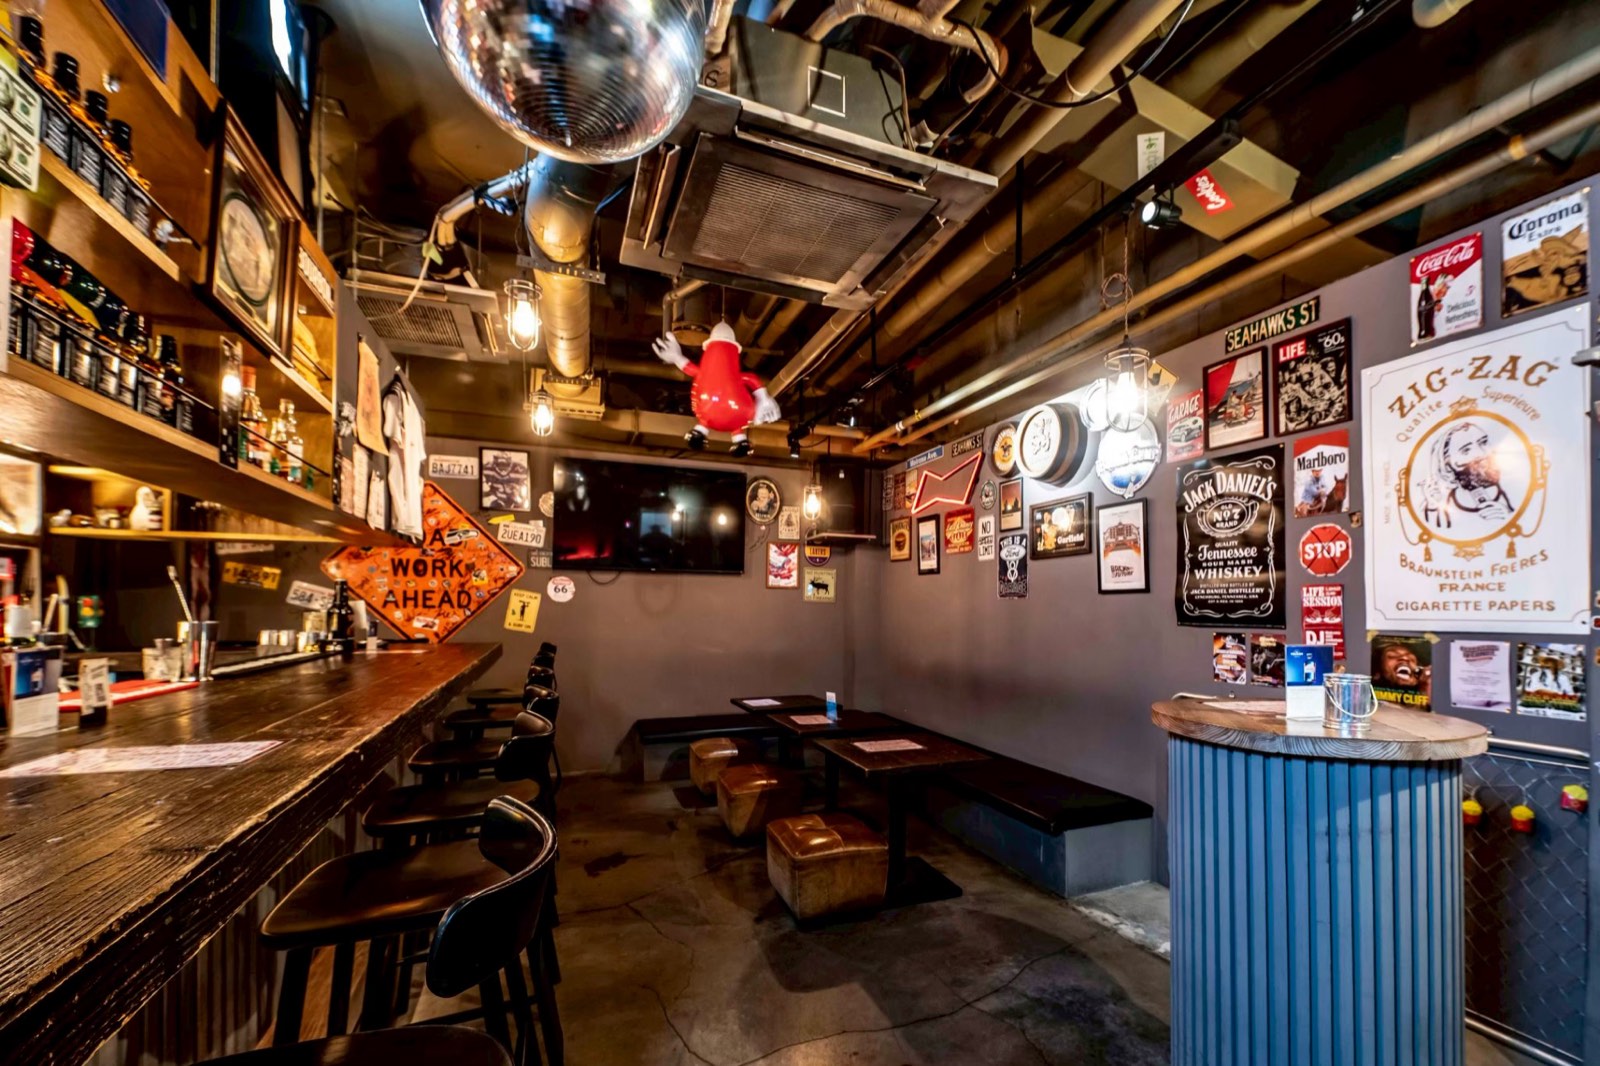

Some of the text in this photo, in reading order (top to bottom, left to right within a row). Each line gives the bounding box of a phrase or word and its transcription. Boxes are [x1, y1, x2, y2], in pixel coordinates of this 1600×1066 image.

[1508, 201, 1584, 241] Corona
[1527, 226, 1562, 242] Extra
[1227, 308, 1295, 352] SEAHAWKS
[1299, 299, 1317, 325] ST
[1279, 341, 1306, 363] LIFE
[1388, 355, 1560, 419] ZIG-ZAG
[1168, 394, 1201, 424] GARAGE
[431, 462, 474, 476] BAJ7741
[1296, 451, 1346, 472] Marlboro
[1183, 471, 1277, 513] JACK DANIEL'S
[981, 521, 991, 535] NO
[1215, 520, 1238, 528] BRAND
[501, 528, 542, 544] 2UEA190
[1000, 535, 1026, 549] THIS IS A
[1057, 532, 1084, 545] Garfield
[1215, 540, 1239, 548] QUALITY
[1198, 544, 1258, 561] Tennessee
[1304, 540, 1347, 561] STOP
[390, 558, 464, 578] WORK
[1194, 565, 1263, 580] WHISKEY
[1399, 553, 1483, 580] BRAUNSTEIN
[553, 585, 568, 593] 66
[1302, 586, 1325, 597] LIFE
[1439, 582, 1506, 592] FRANCE
[381, 590, 472, 609] AHEAD
[1302, 596, 1343, 607] SESSION
[1395, 600, 1556, 611] CIGARETTE PAPERS
[1305, 630, 1325, 646] DJ
[1403, 693, 1429, 706] CLIFF
